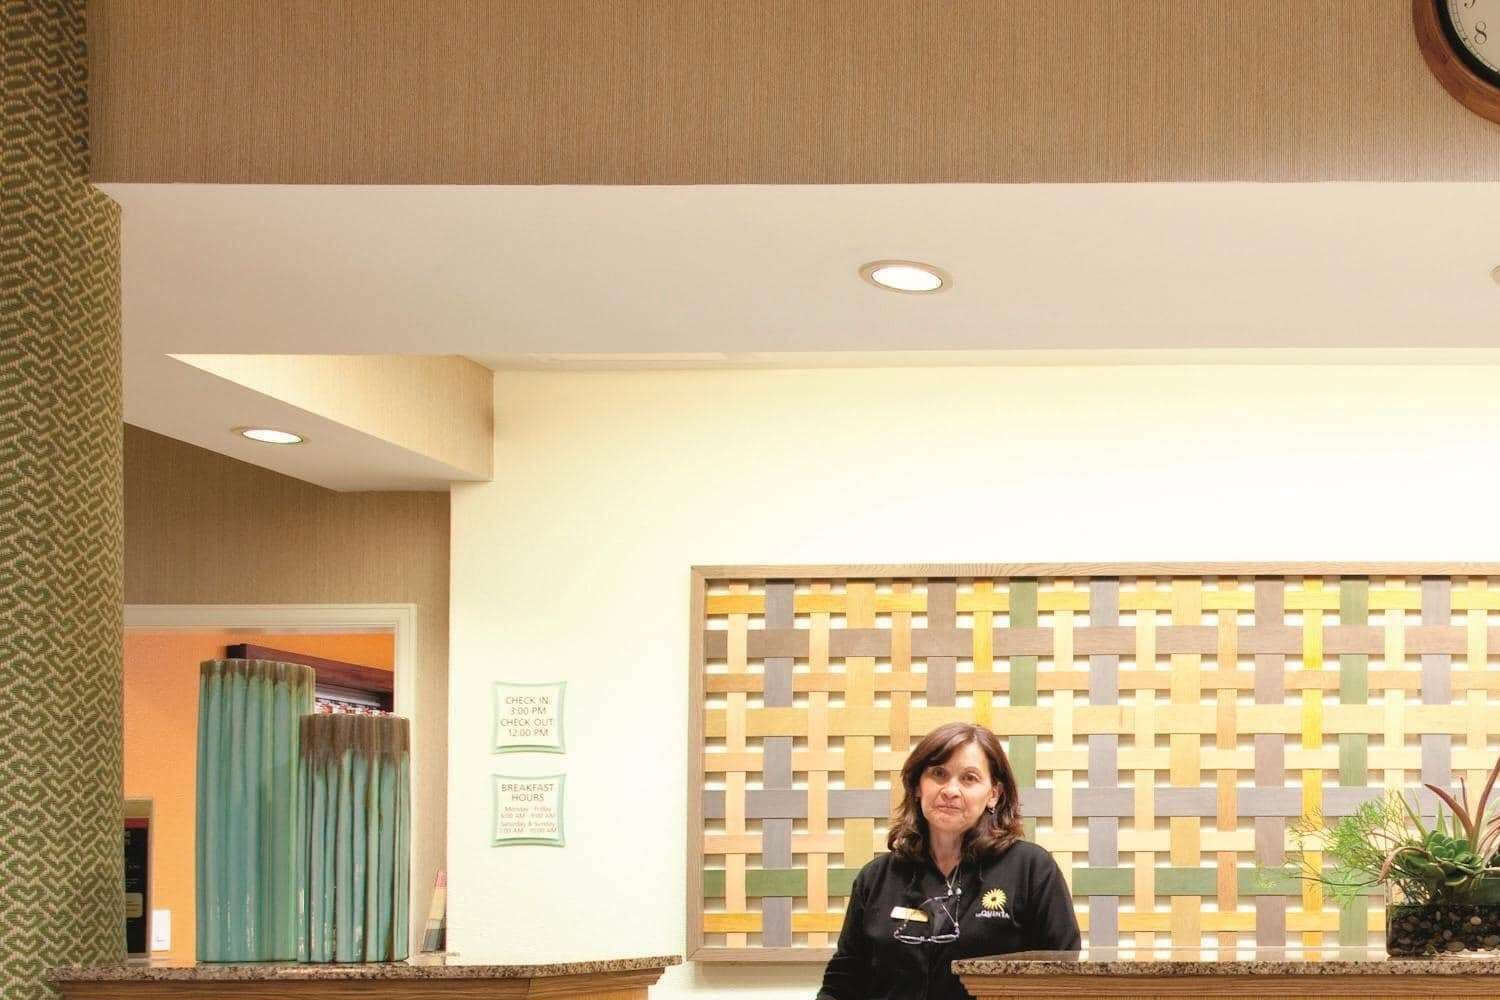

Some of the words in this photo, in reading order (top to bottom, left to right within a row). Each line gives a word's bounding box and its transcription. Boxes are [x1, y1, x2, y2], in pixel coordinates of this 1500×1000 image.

[1473, 20, 1488, 45] 8
[505, 696, 536, 704] CHECK
[532, 706, 547, 715] PM
[500, 718, 531, 727] CHECK
[534, 728, 549, 737] PM
[501, 783, 554, 792] BREAKFAST
[511, 793, 545, 802] HOURS
[981, 910, 1010, 919] QUINTA
